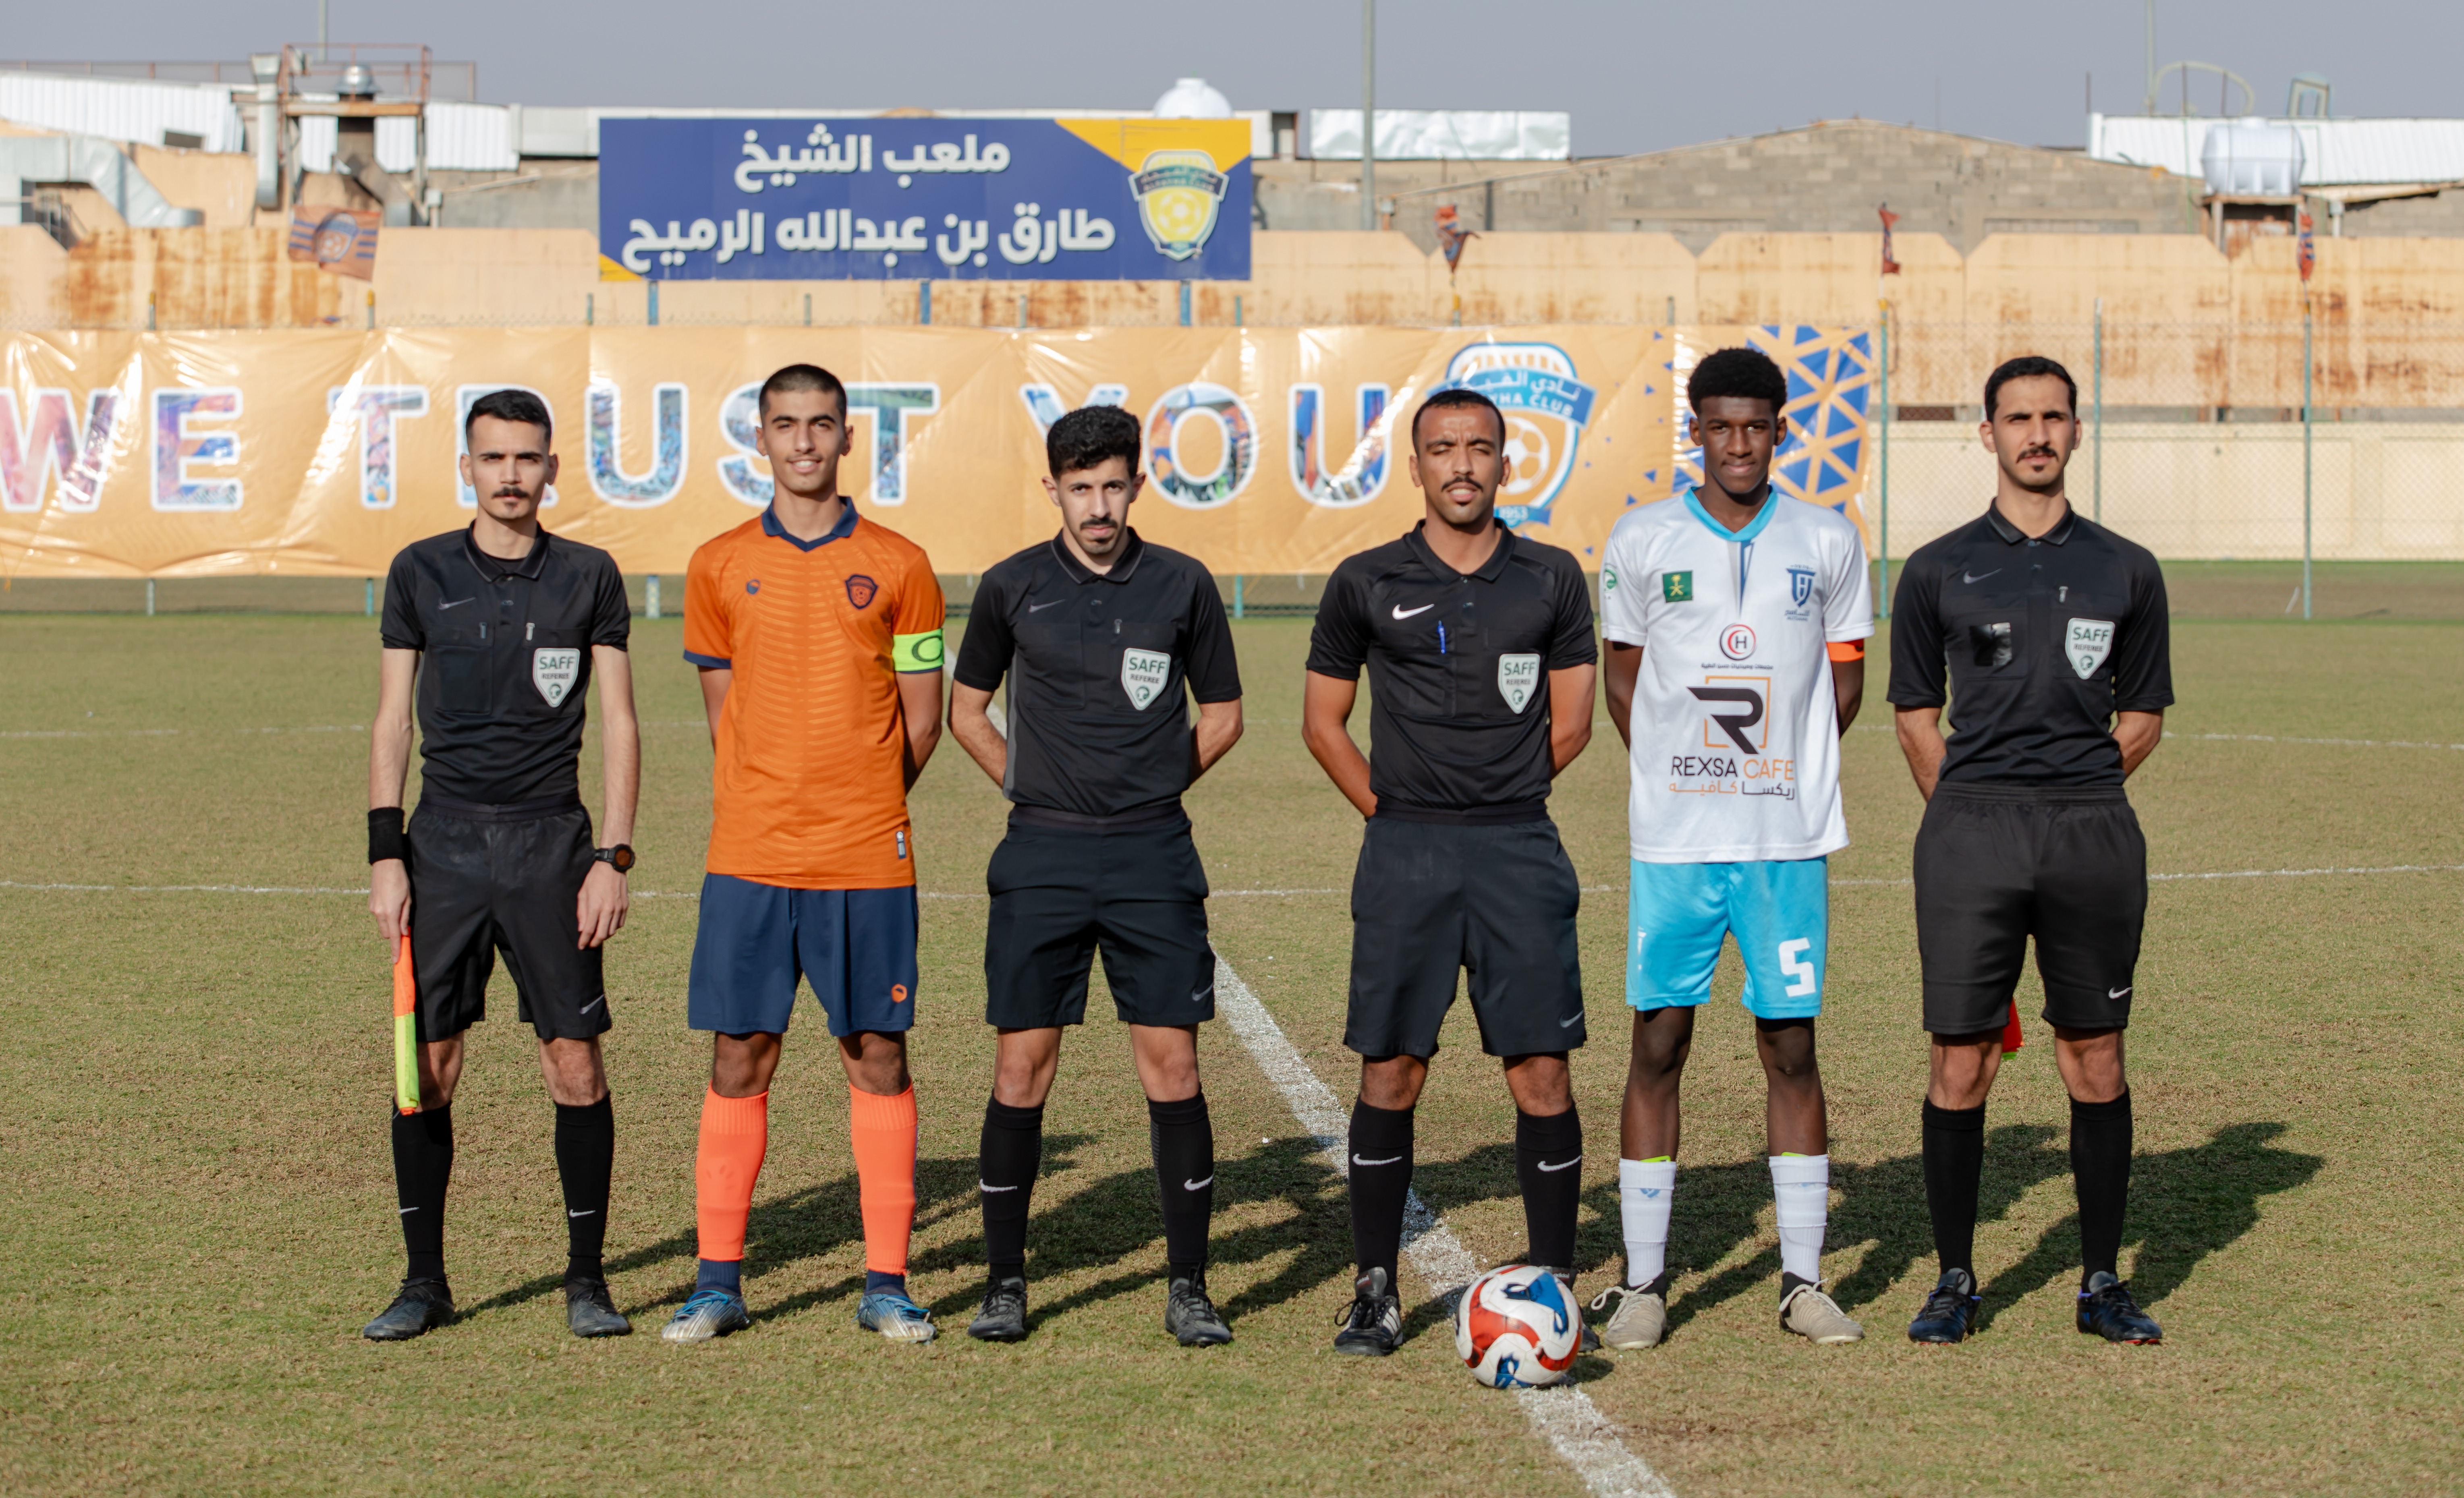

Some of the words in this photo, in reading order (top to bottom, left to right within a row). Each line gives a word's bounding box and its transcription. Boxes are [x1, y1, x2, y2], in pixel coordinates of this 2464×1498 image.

[734, 123, 872, 193] الشيخ
[882, 134, 1011, 188] ملعب
[622, 208, 765, 273] الرميح
[775, 208, 927, 267] عبدالله
[936, 213, 988, 267] بن
[998, 202, 1116, 264] طارق
[1529, 393, 1574, 417] CLUB
[0, 386, 243, 512] WE
[2073, 627, 2109, 642] SAFF
[539, 656, 575, 669] SAFF
[1129, 657, 1166, 673] SAFF
[1504, 661, 1536, 675] SAFF
[1130, 673, 1160, 684] REFEREE
[1671, 756, 1738, 777] REXSA
[1743, 758, 1794, 781] CAFE
[1669, 780, 1738, 796] كافيه
[1742, 781, 1795, 800] ريكسا
[1778, 937, 1816, 998] 5
